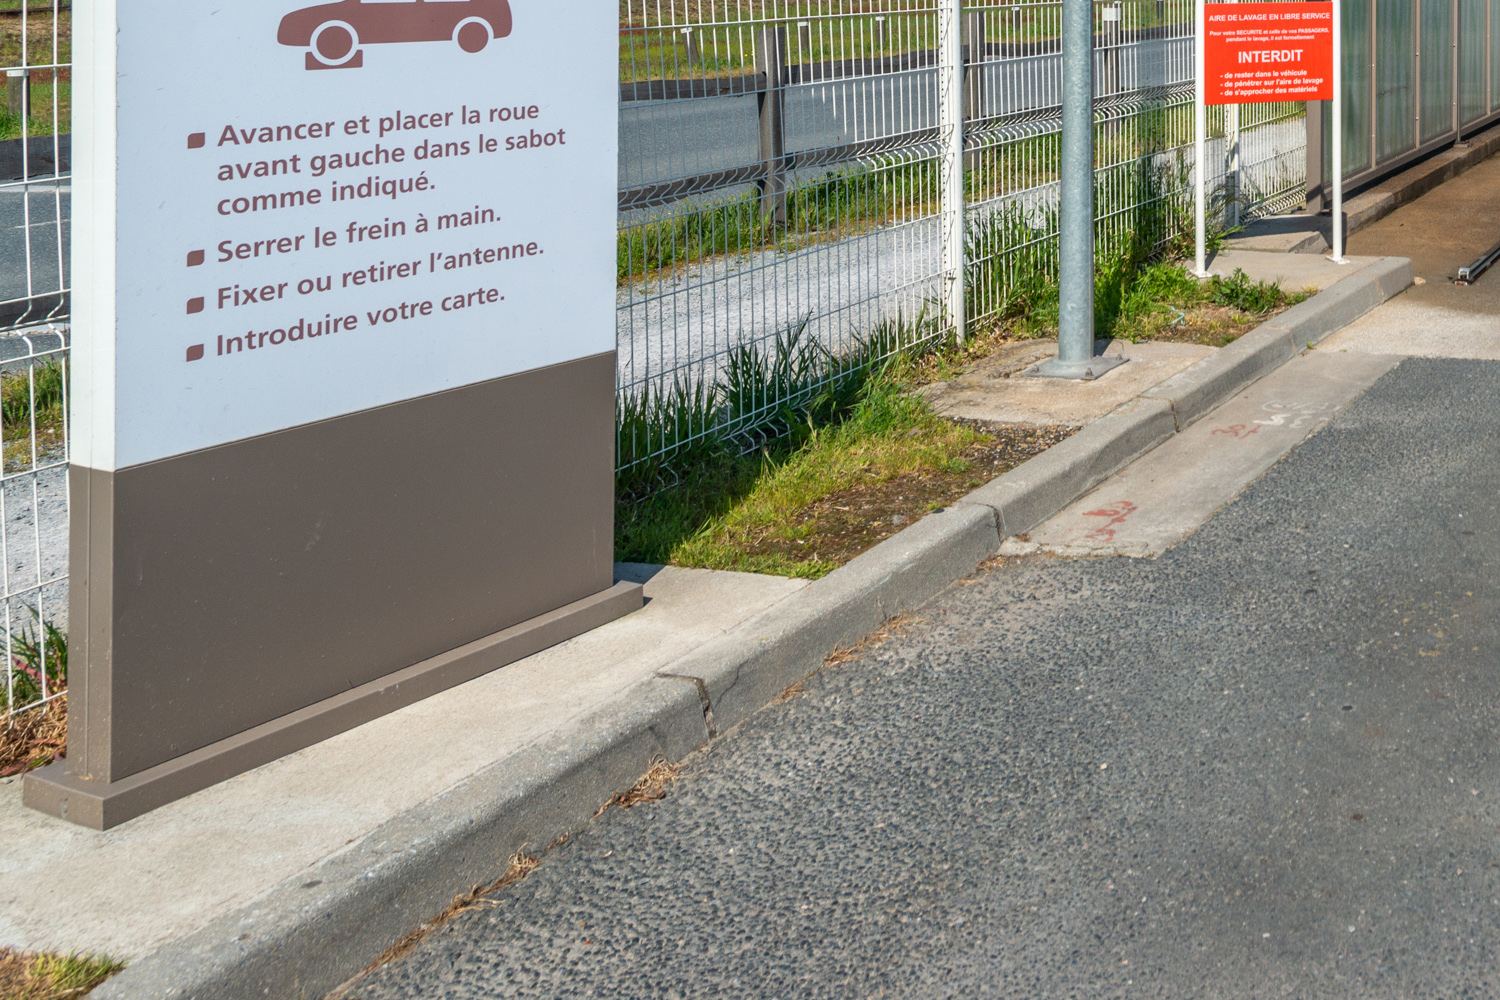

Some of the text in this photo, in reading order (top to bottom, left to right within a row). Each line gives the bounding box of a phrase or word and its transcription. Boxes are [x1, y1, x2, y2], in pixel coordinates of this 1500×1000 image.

[1238, 50, 1303, 63] INTERDIT
[1235, 88, 1273, 96] s'approcher
[217, 103, 539, 146] Avancer et placer la roue
[217, 128, 566, 181] avant gauche dans le sabot
[217, 171, 435, 216] comme indiqué.
[217, 205, 501, 263] Serrer le frein à main.
[217, 239, 544, 309] Fixer ou retirer l'antenne.
[217, 287, 505, 356] Introduire votre carte.
